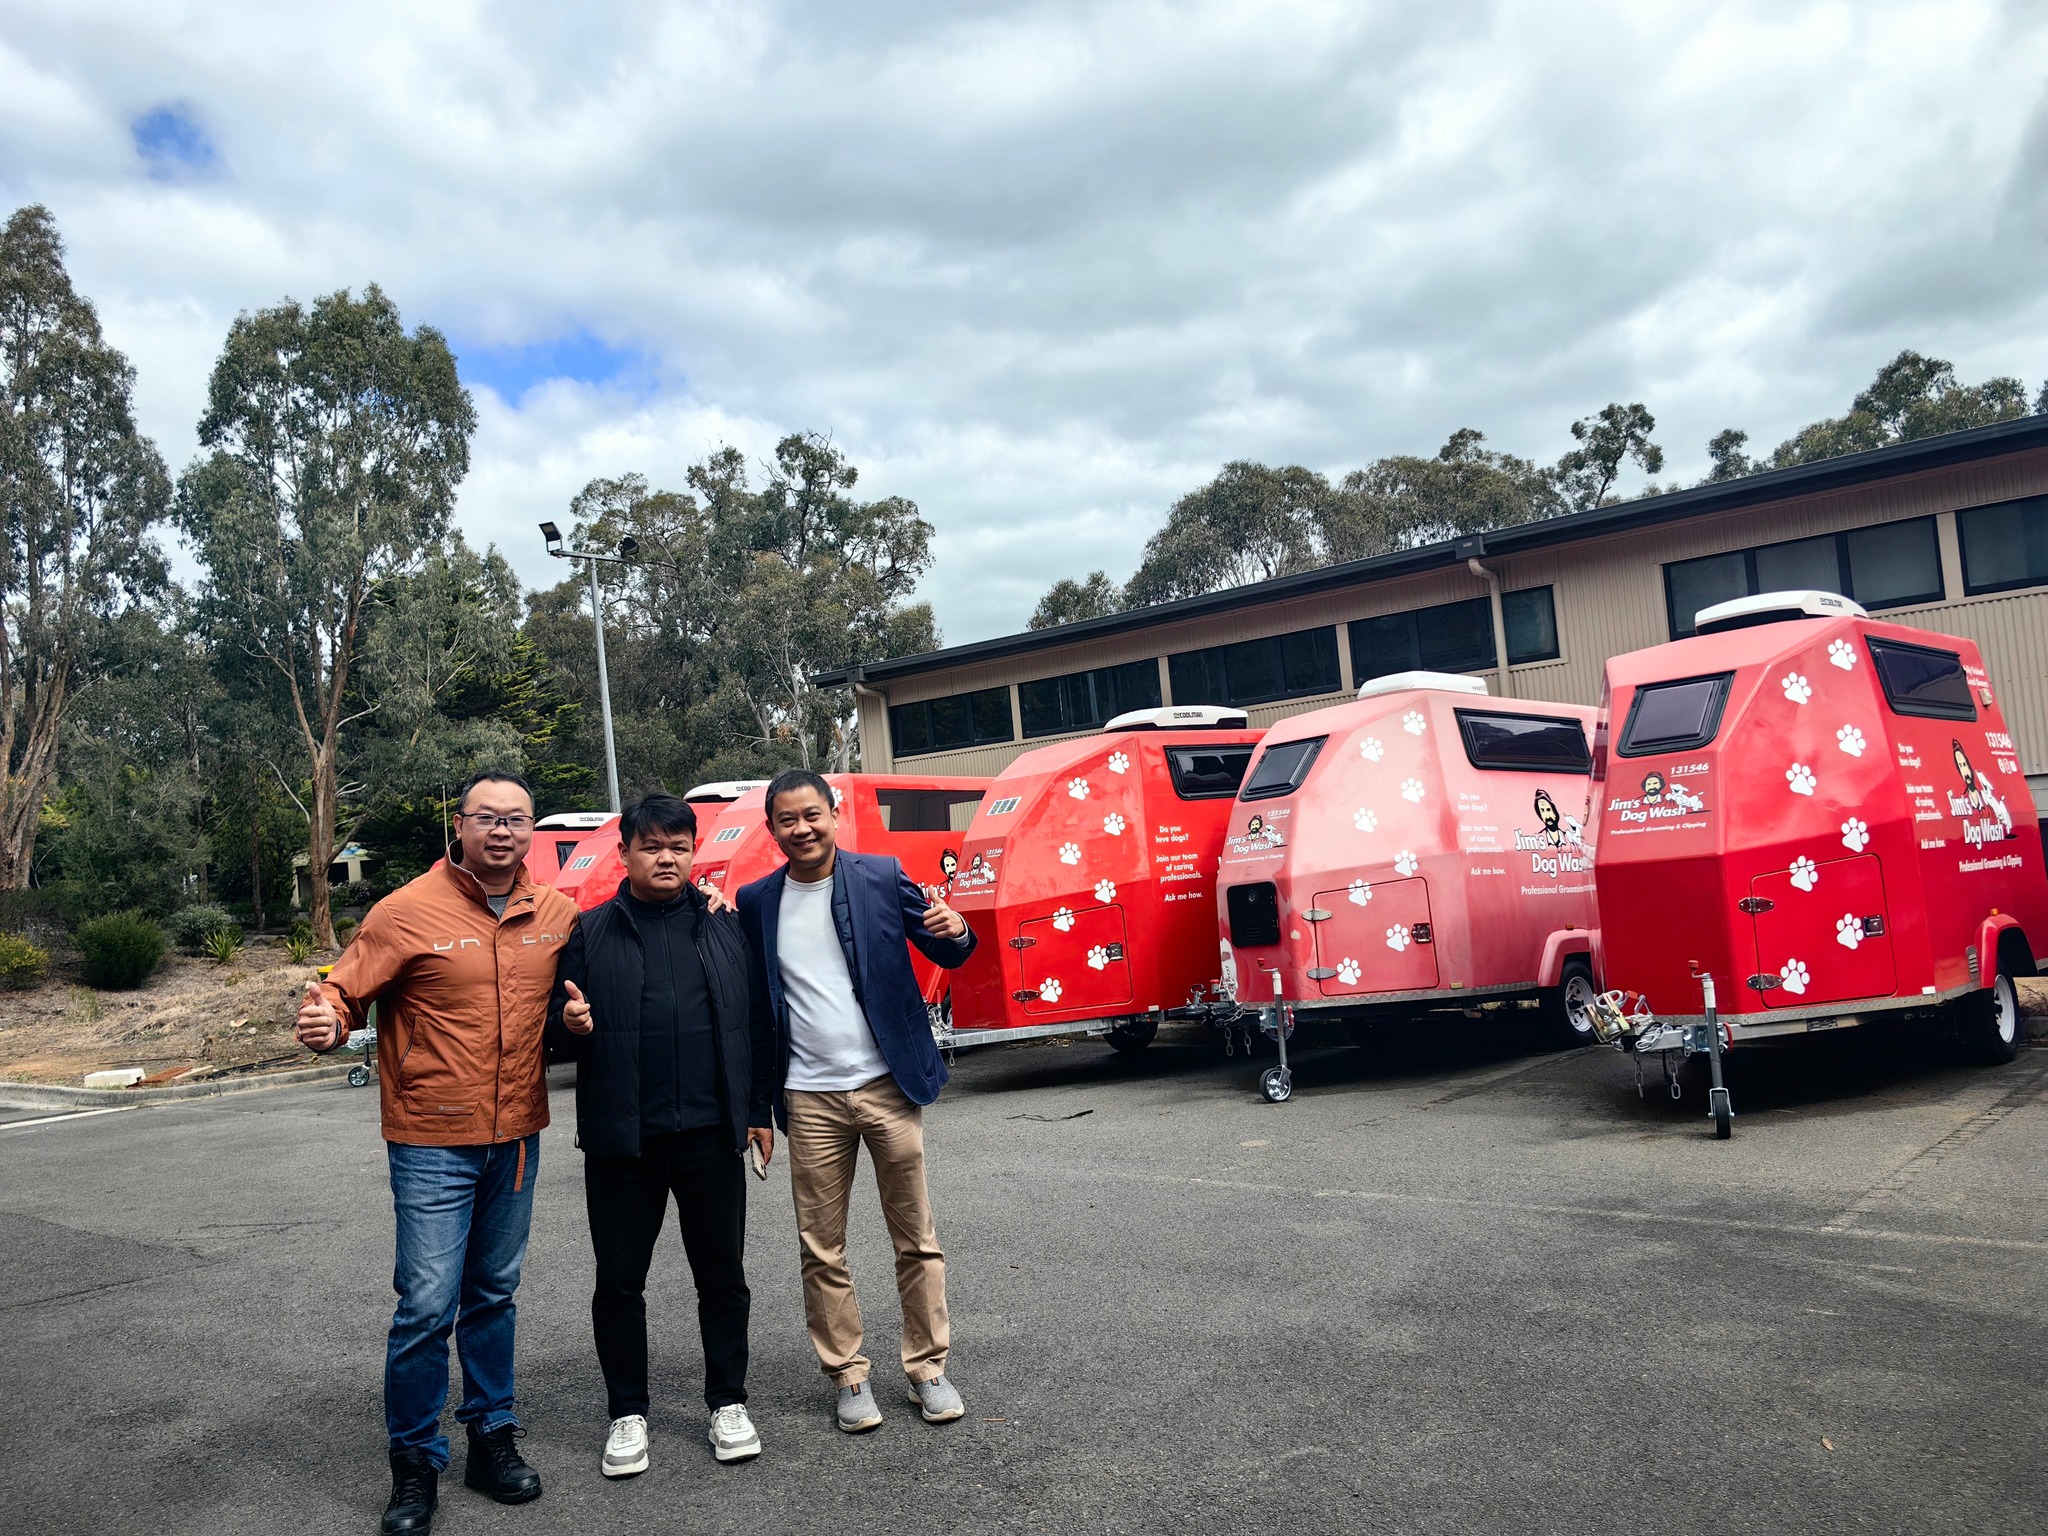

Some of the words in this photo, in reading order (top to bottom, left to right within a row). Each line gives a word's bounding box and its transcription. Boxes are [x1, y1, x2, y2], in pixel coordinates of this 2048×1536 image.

[1985, 732, 2012, 748] 131546
[1670, 763, 1709, 774] 131546
[1608, 798, 1640, 811] Jim's
[1947, 790, 1973, 816] Jim's
[1267, 808, 1290, 817] 131546
[1621, 810, 1647, 822] Dog
[1649, 805, 1686, 818] Wash
[1171, 834, 1189, 842] dogs?
[1514, 828, 1546, 851] Jim's
[1963, 819, 1982, 850] Dog
[1980, 818, 2004, 842] Wash
[1226, 836, 1246, 845] Jim's
[1233, 845, 1250, 854] Dog
[1251, 841, 1273, 851] Wash
[1471, 867, 1481, 875] Ask
[1532, 852, 1557, 878] Dog
[955, 871, 970, 879] Jim's
[1160, 871, 1202, 884] professionals.
[959, 879, 970, 888] Dog
[972, 877, 987, 886] Wash
[1521, 886, 1557, 895] Professional
[1559, 885, 1584, 893] Groomin
[1164, 893, 1176, 901] Ask
